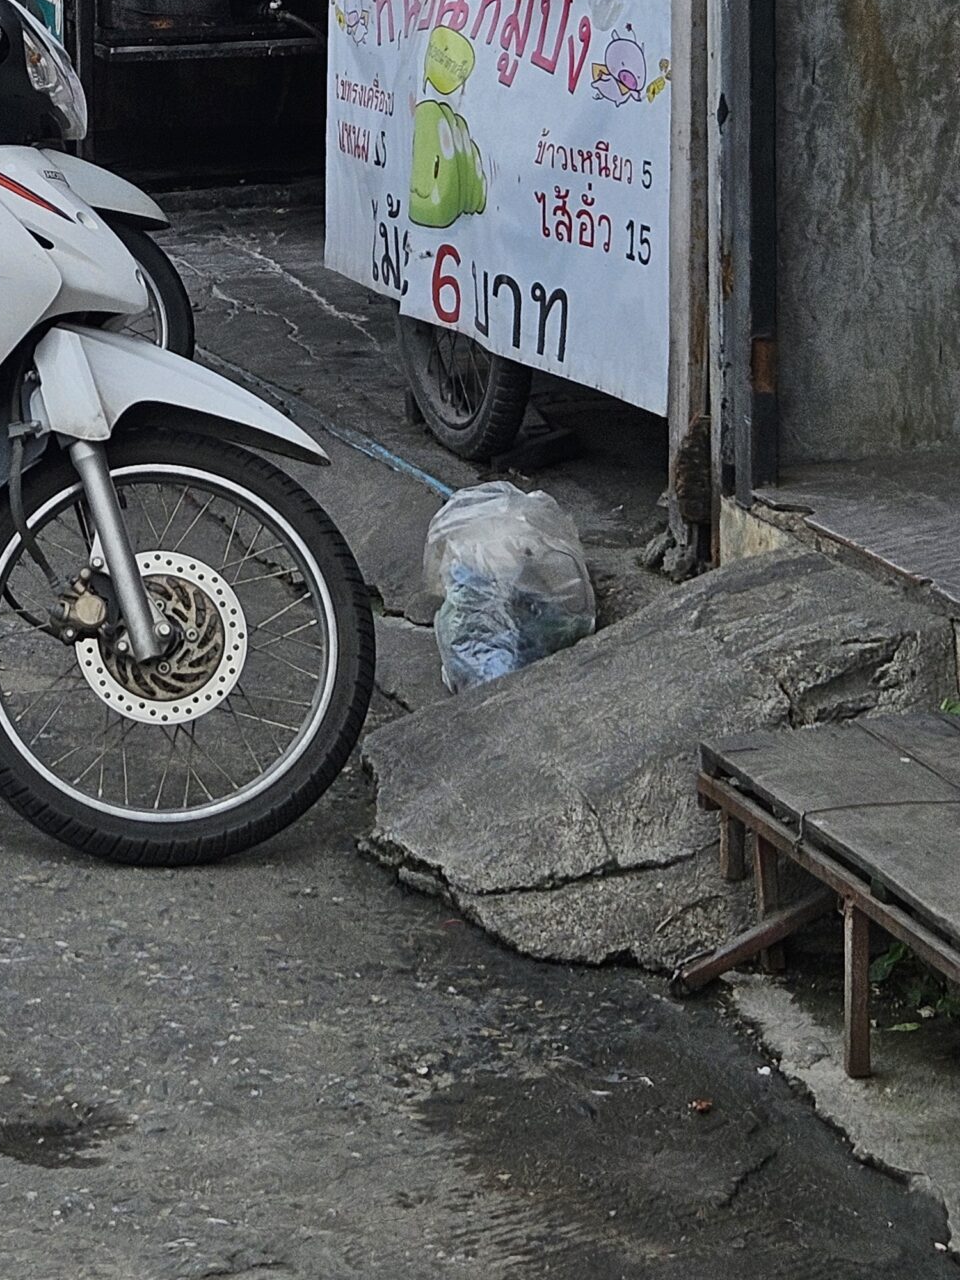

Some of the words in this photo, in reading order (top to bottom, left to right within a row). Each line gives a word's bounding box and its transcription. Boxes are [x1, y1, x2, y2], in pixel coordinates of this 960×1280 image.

[338, 120, 370, 163] แหนม
[534, 127, 634, 186] ข้าวเหนียว
[641, 159, 654, 190] 5
[534, 182, 612, 254] ไส้อั่ว
[625, 219, 652, 267] 15
[432, 243, 461, 324] 6
[471, 260, 569, 363] บาท
